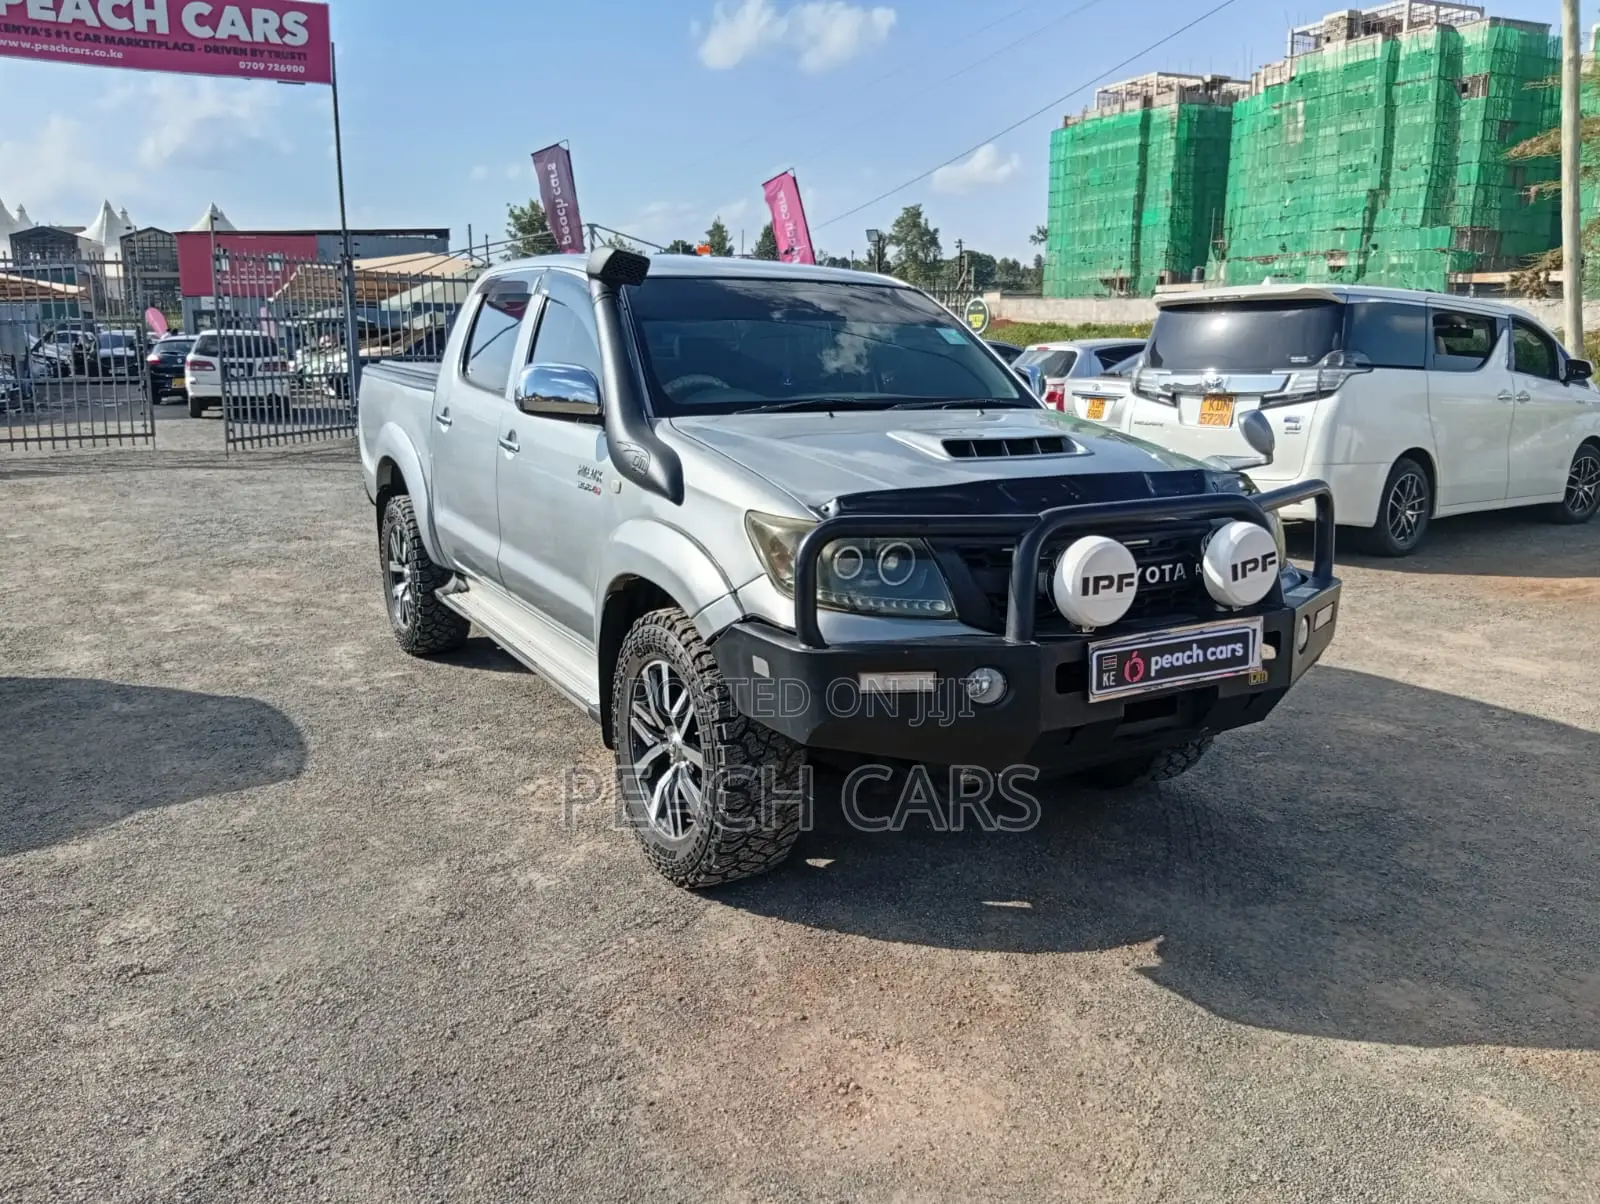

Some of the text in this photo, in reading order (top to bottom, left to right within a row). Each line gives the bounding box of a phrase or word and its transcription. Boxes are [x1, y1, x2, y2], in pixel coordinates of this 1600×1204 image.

[181, 1, 309, 46] CARS
[54, 29, 70, 40] #1
[73, 31, 102, 43] CAR
[104, 34, 196, 52] MARKETPLACE
[204, 44, 248, 57] DRIVEN
[250, 48, 266, 58] BY
[238, 61, 305, 73] 0709 726900
[1136, 562, 1187, 584] YOTA
[1231, 551, 1277, 583] IPF
[1081, 572, 1136, 597] IPF
[1150, 641, 1244, 676] peach cars
[1102, 671, 1116, 687] KE
